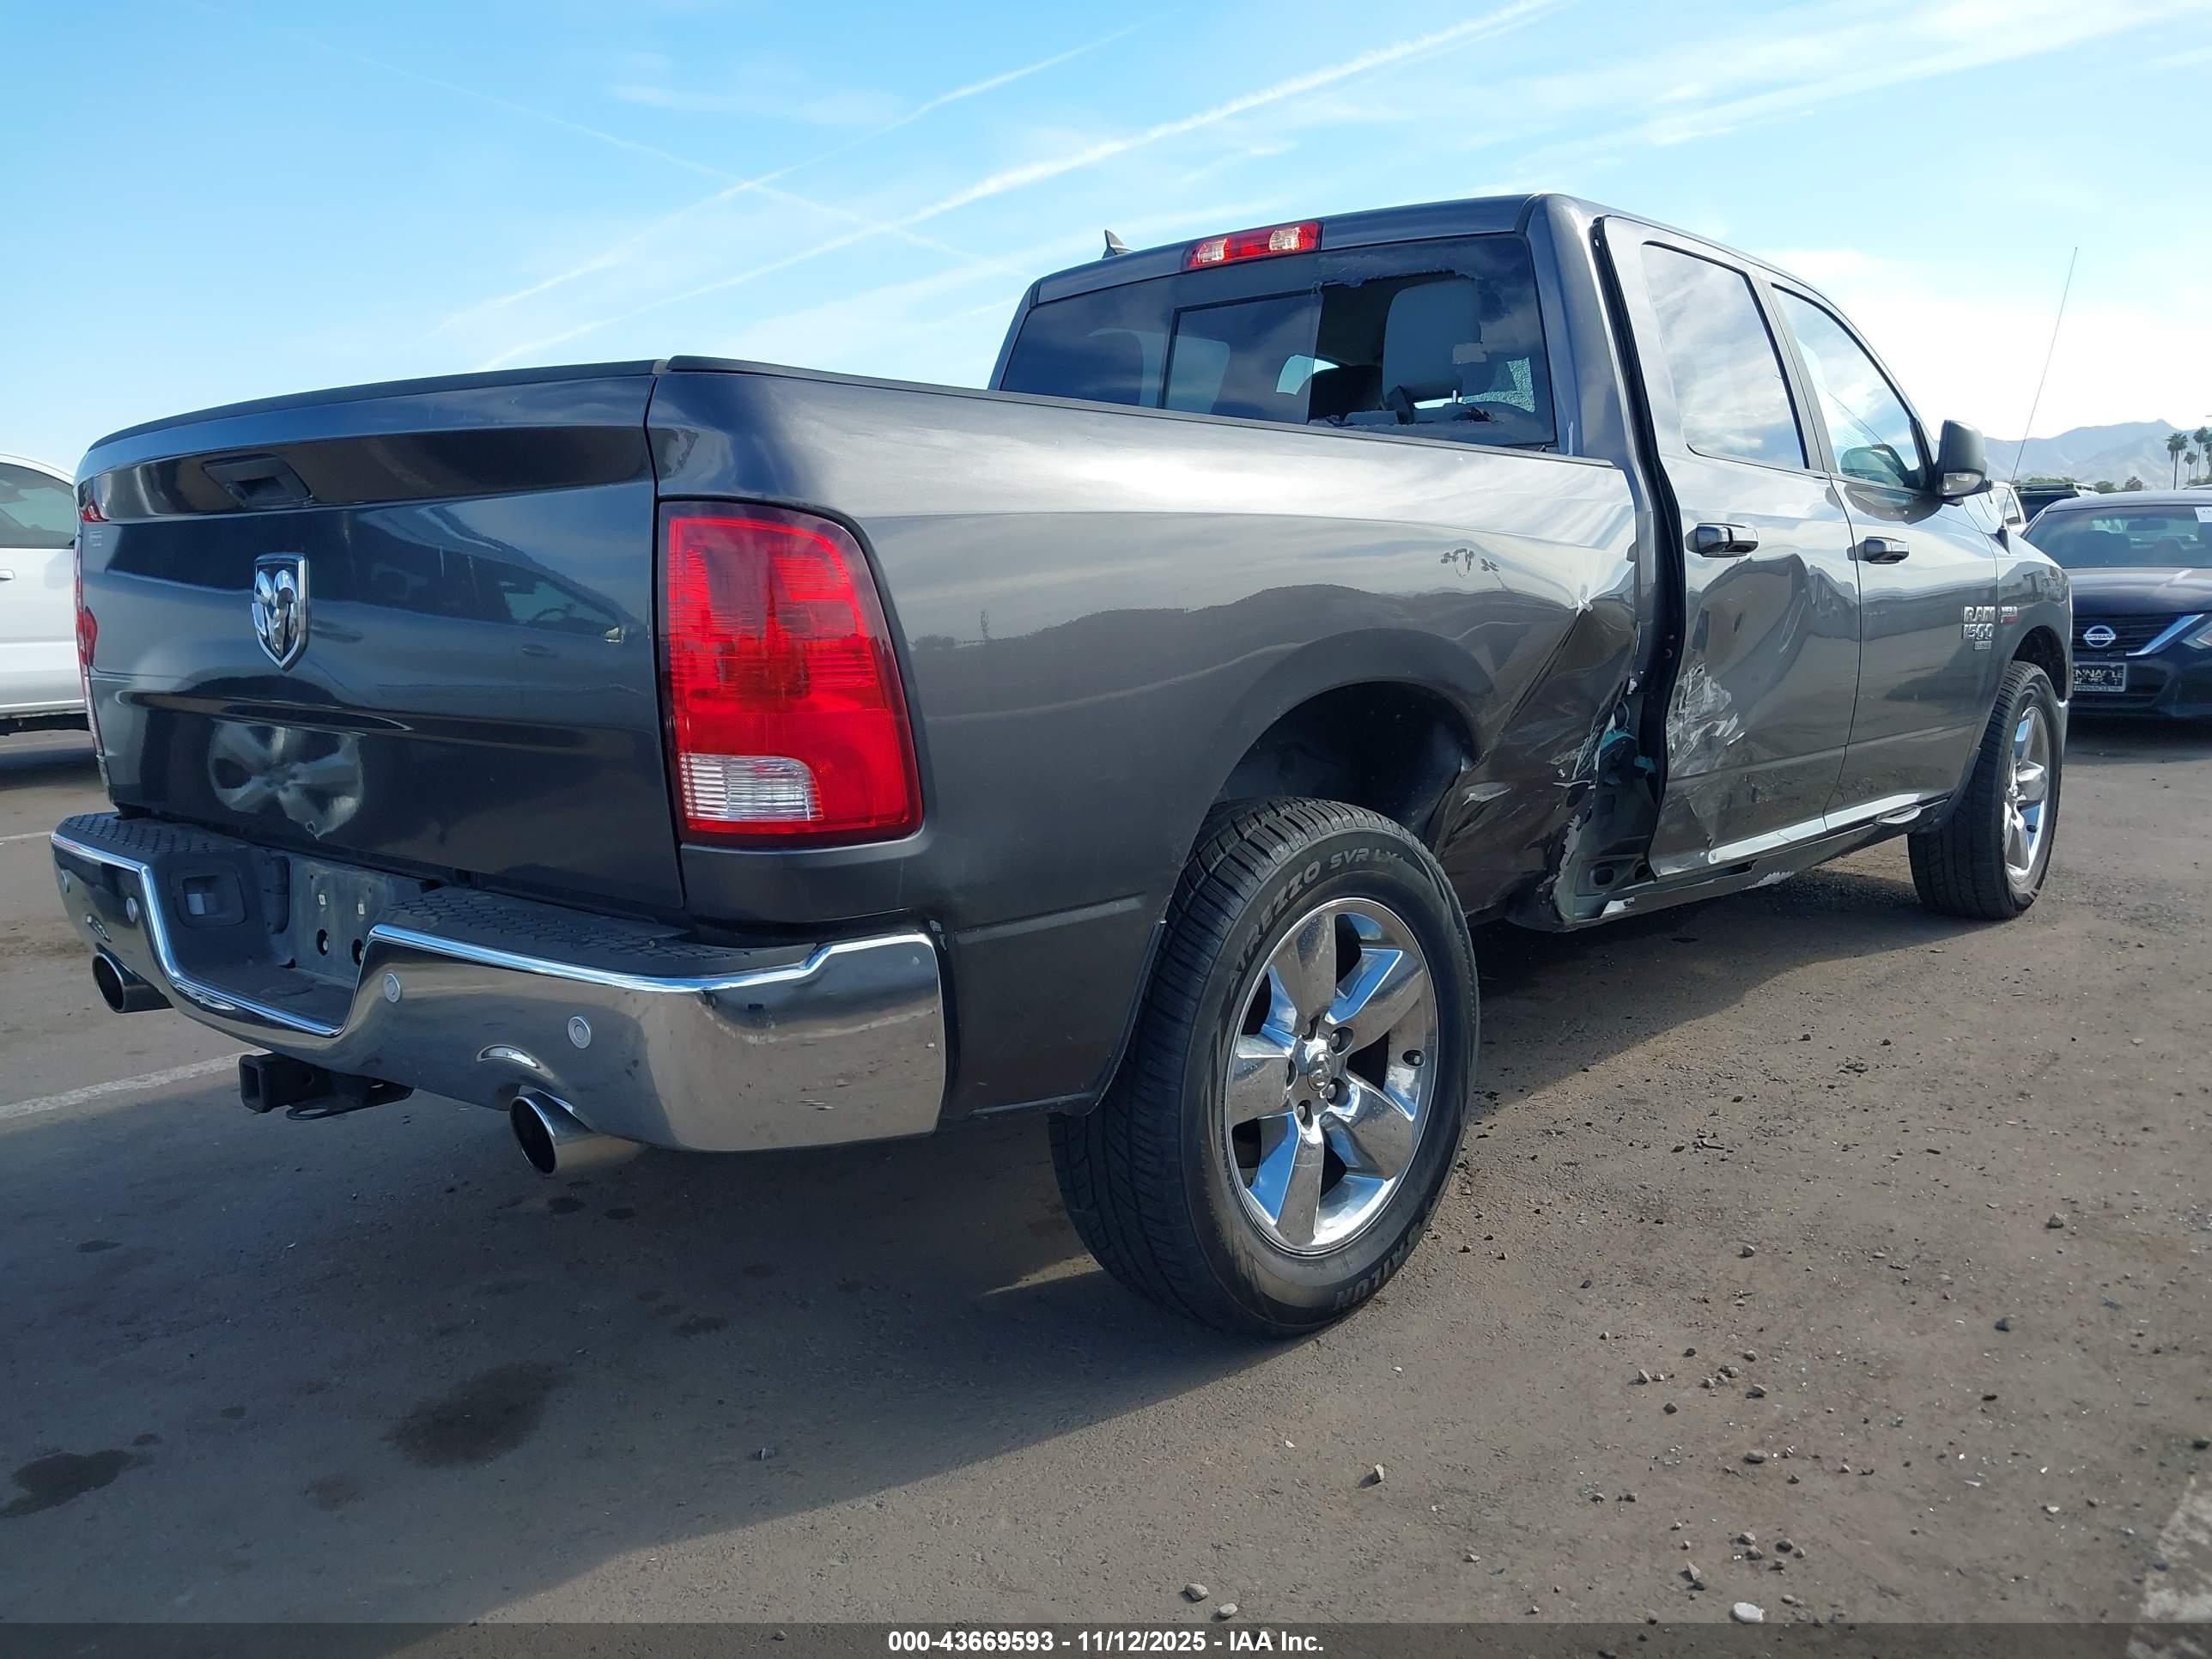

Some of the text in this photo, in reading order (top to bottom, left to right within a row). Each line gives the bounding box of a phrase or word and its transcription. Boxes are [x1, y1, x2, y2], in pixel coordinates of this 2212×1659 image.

[1964, 605, 1996, 623] RAM
[1963, 623, 1995, 641] 1500
[1329, 847, 1370, 870] SVR
